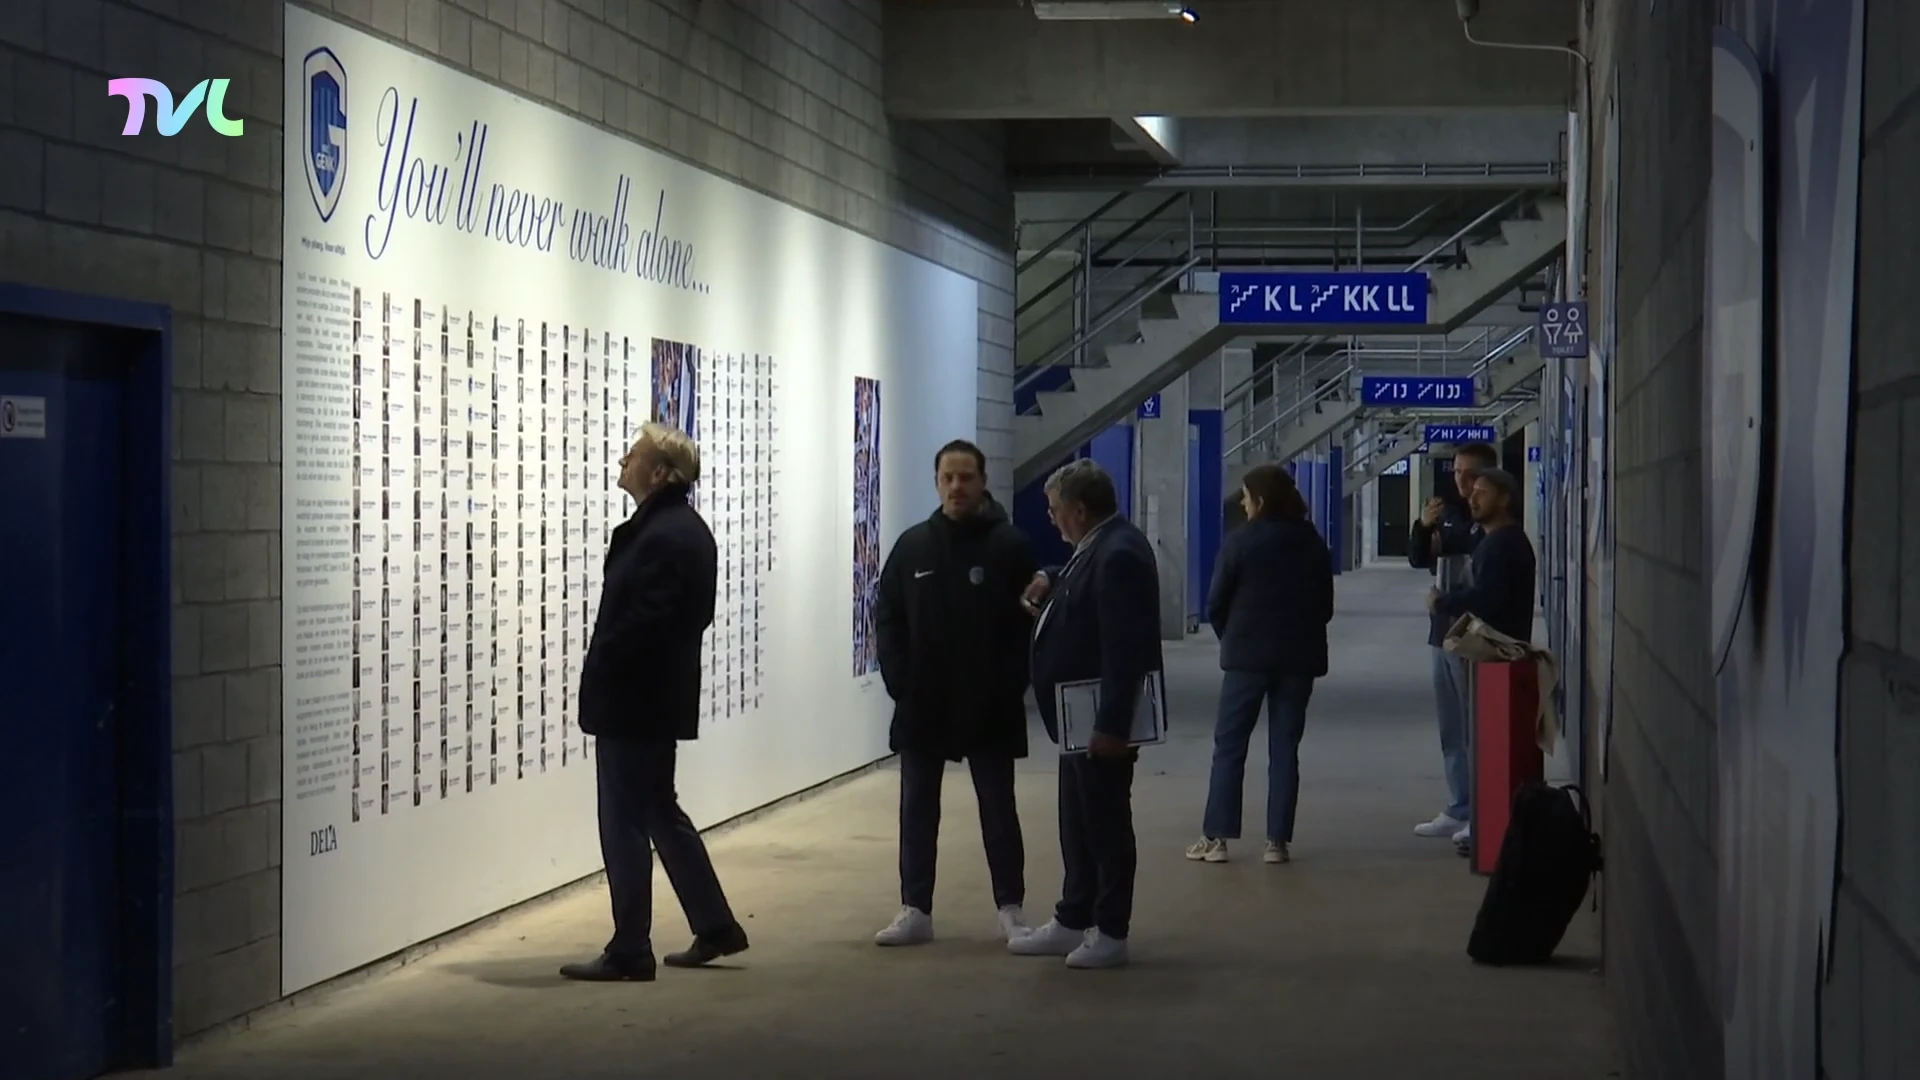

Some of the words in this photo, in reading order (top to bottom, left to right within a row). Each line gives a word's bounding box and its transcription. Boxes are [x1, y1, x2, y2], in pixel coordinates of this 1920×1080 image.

[316, 152, 336, 173] GENK
[365, 86, 482, 260] You'll
[484, 182, 565, 252] never
[569, 174, 634, 274] walk
[636, 189, 710, 294] alone...
[1265, 285, 1282, 311] K
[1290, 285, 1302, 311] L
[1344, 285, 1380, 311] KK
[1387, 284, 1415, 311] LL
[310, 825, 337, 857] DELA
